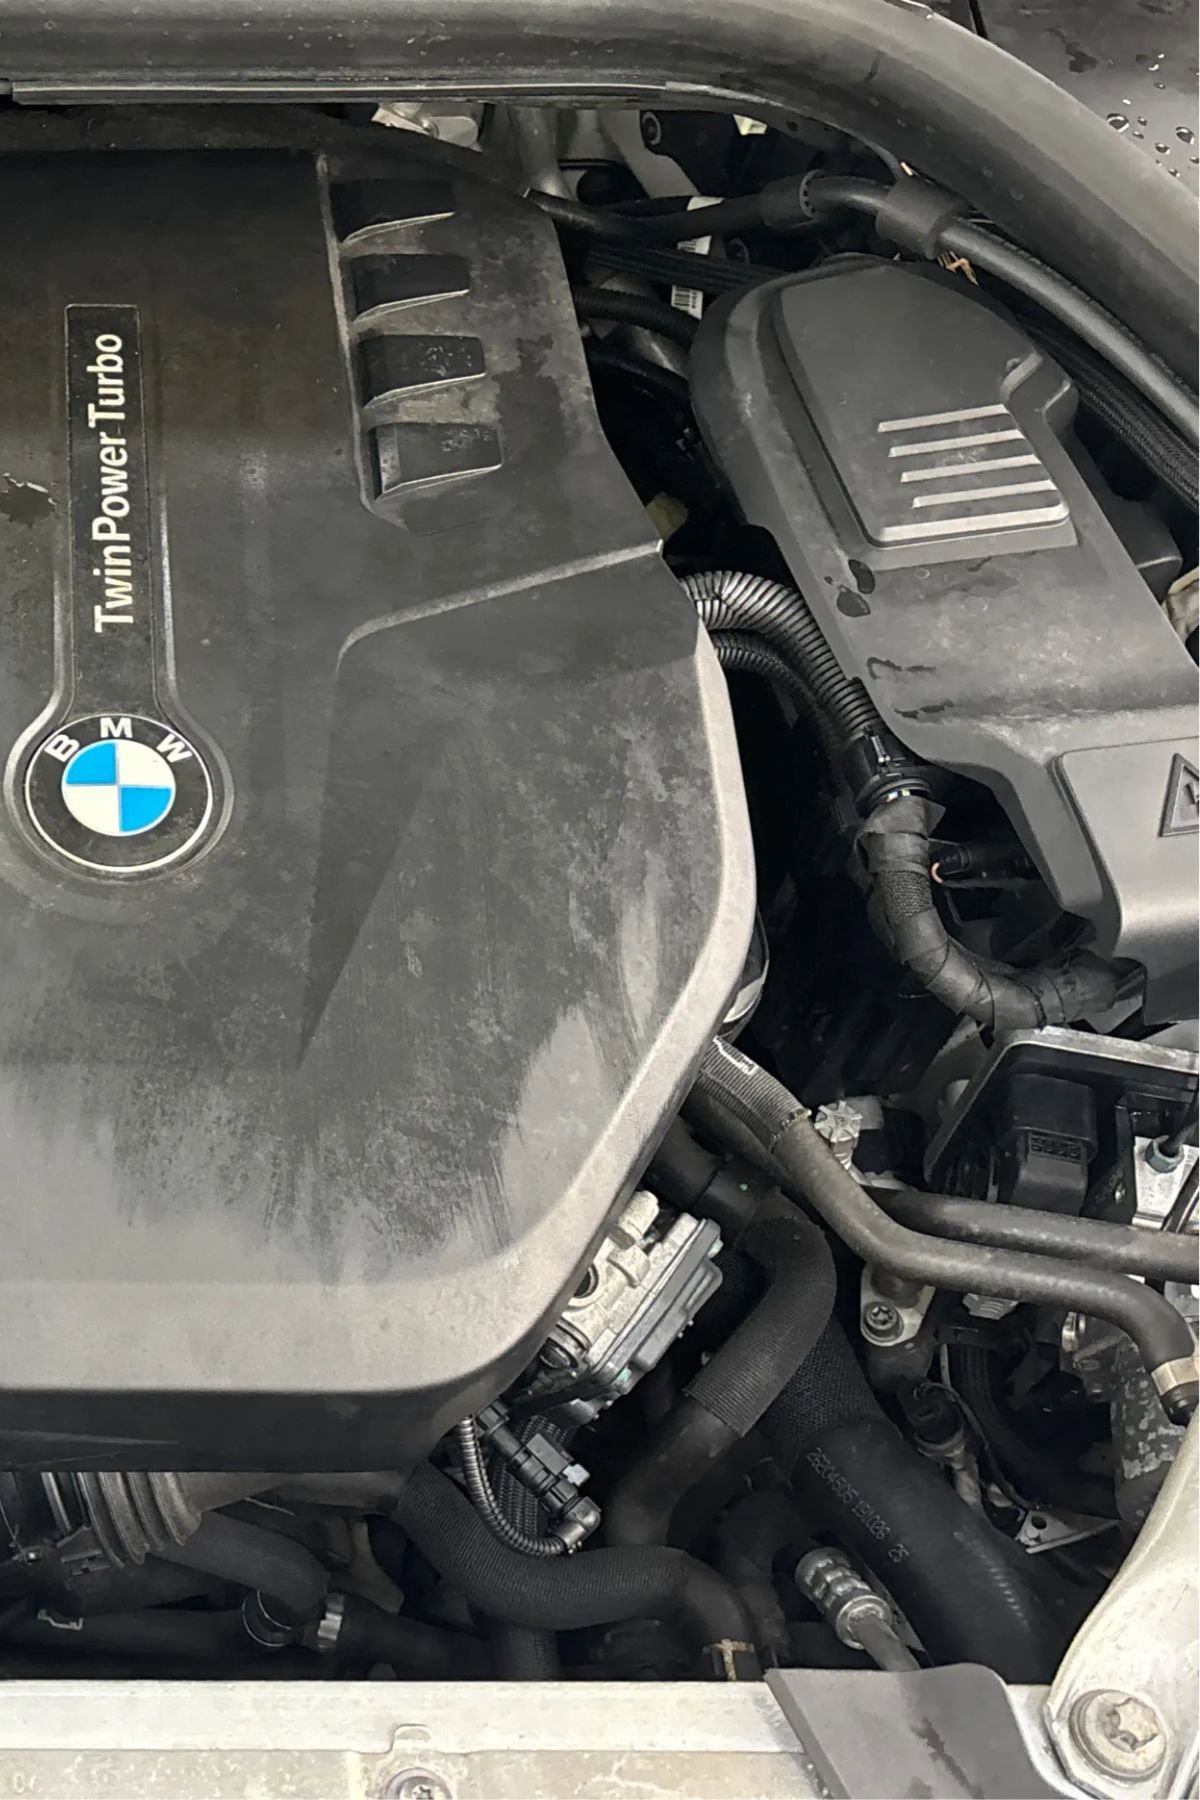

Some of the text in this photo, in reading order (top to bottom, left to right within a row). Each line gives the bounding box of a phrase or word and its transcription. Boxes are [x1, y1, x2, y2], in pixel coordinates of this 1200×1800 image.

[86, 333, 135, 633] TwinPower Turbo
[44, 717, 193, 763] BMW
